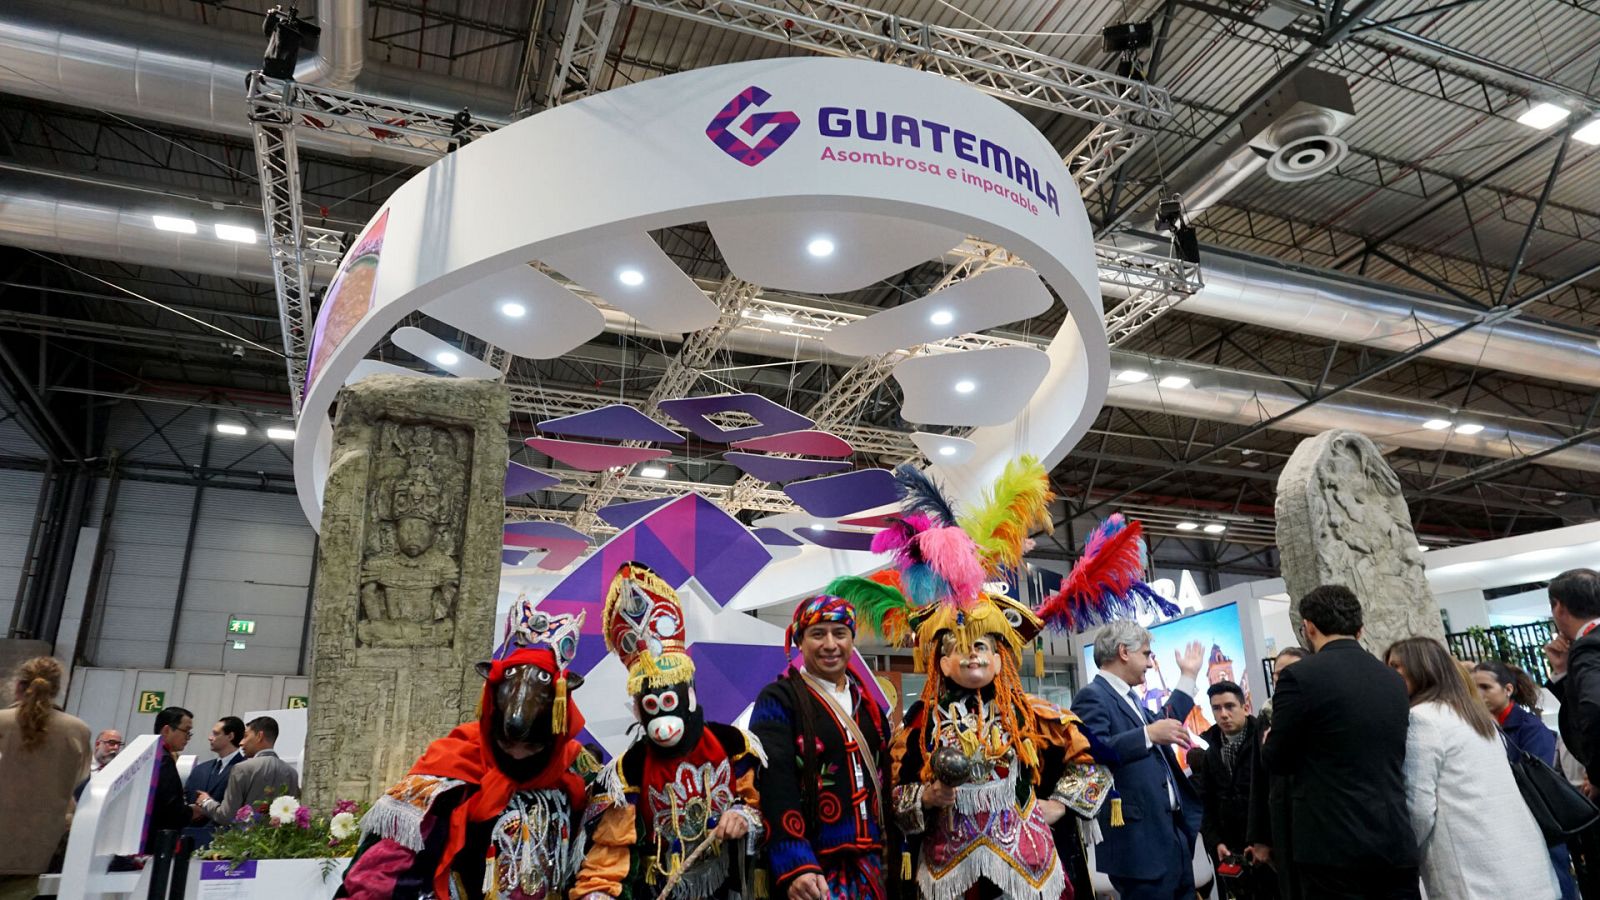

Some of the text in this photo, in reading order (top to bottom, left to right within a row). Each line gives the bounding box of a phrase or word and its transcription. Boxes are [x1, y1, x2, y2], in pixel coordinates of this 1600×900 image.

[818, 107, 1060, 217] GUATEMALA
[820, 146, 1039, 216] Asombrosa e imparable
